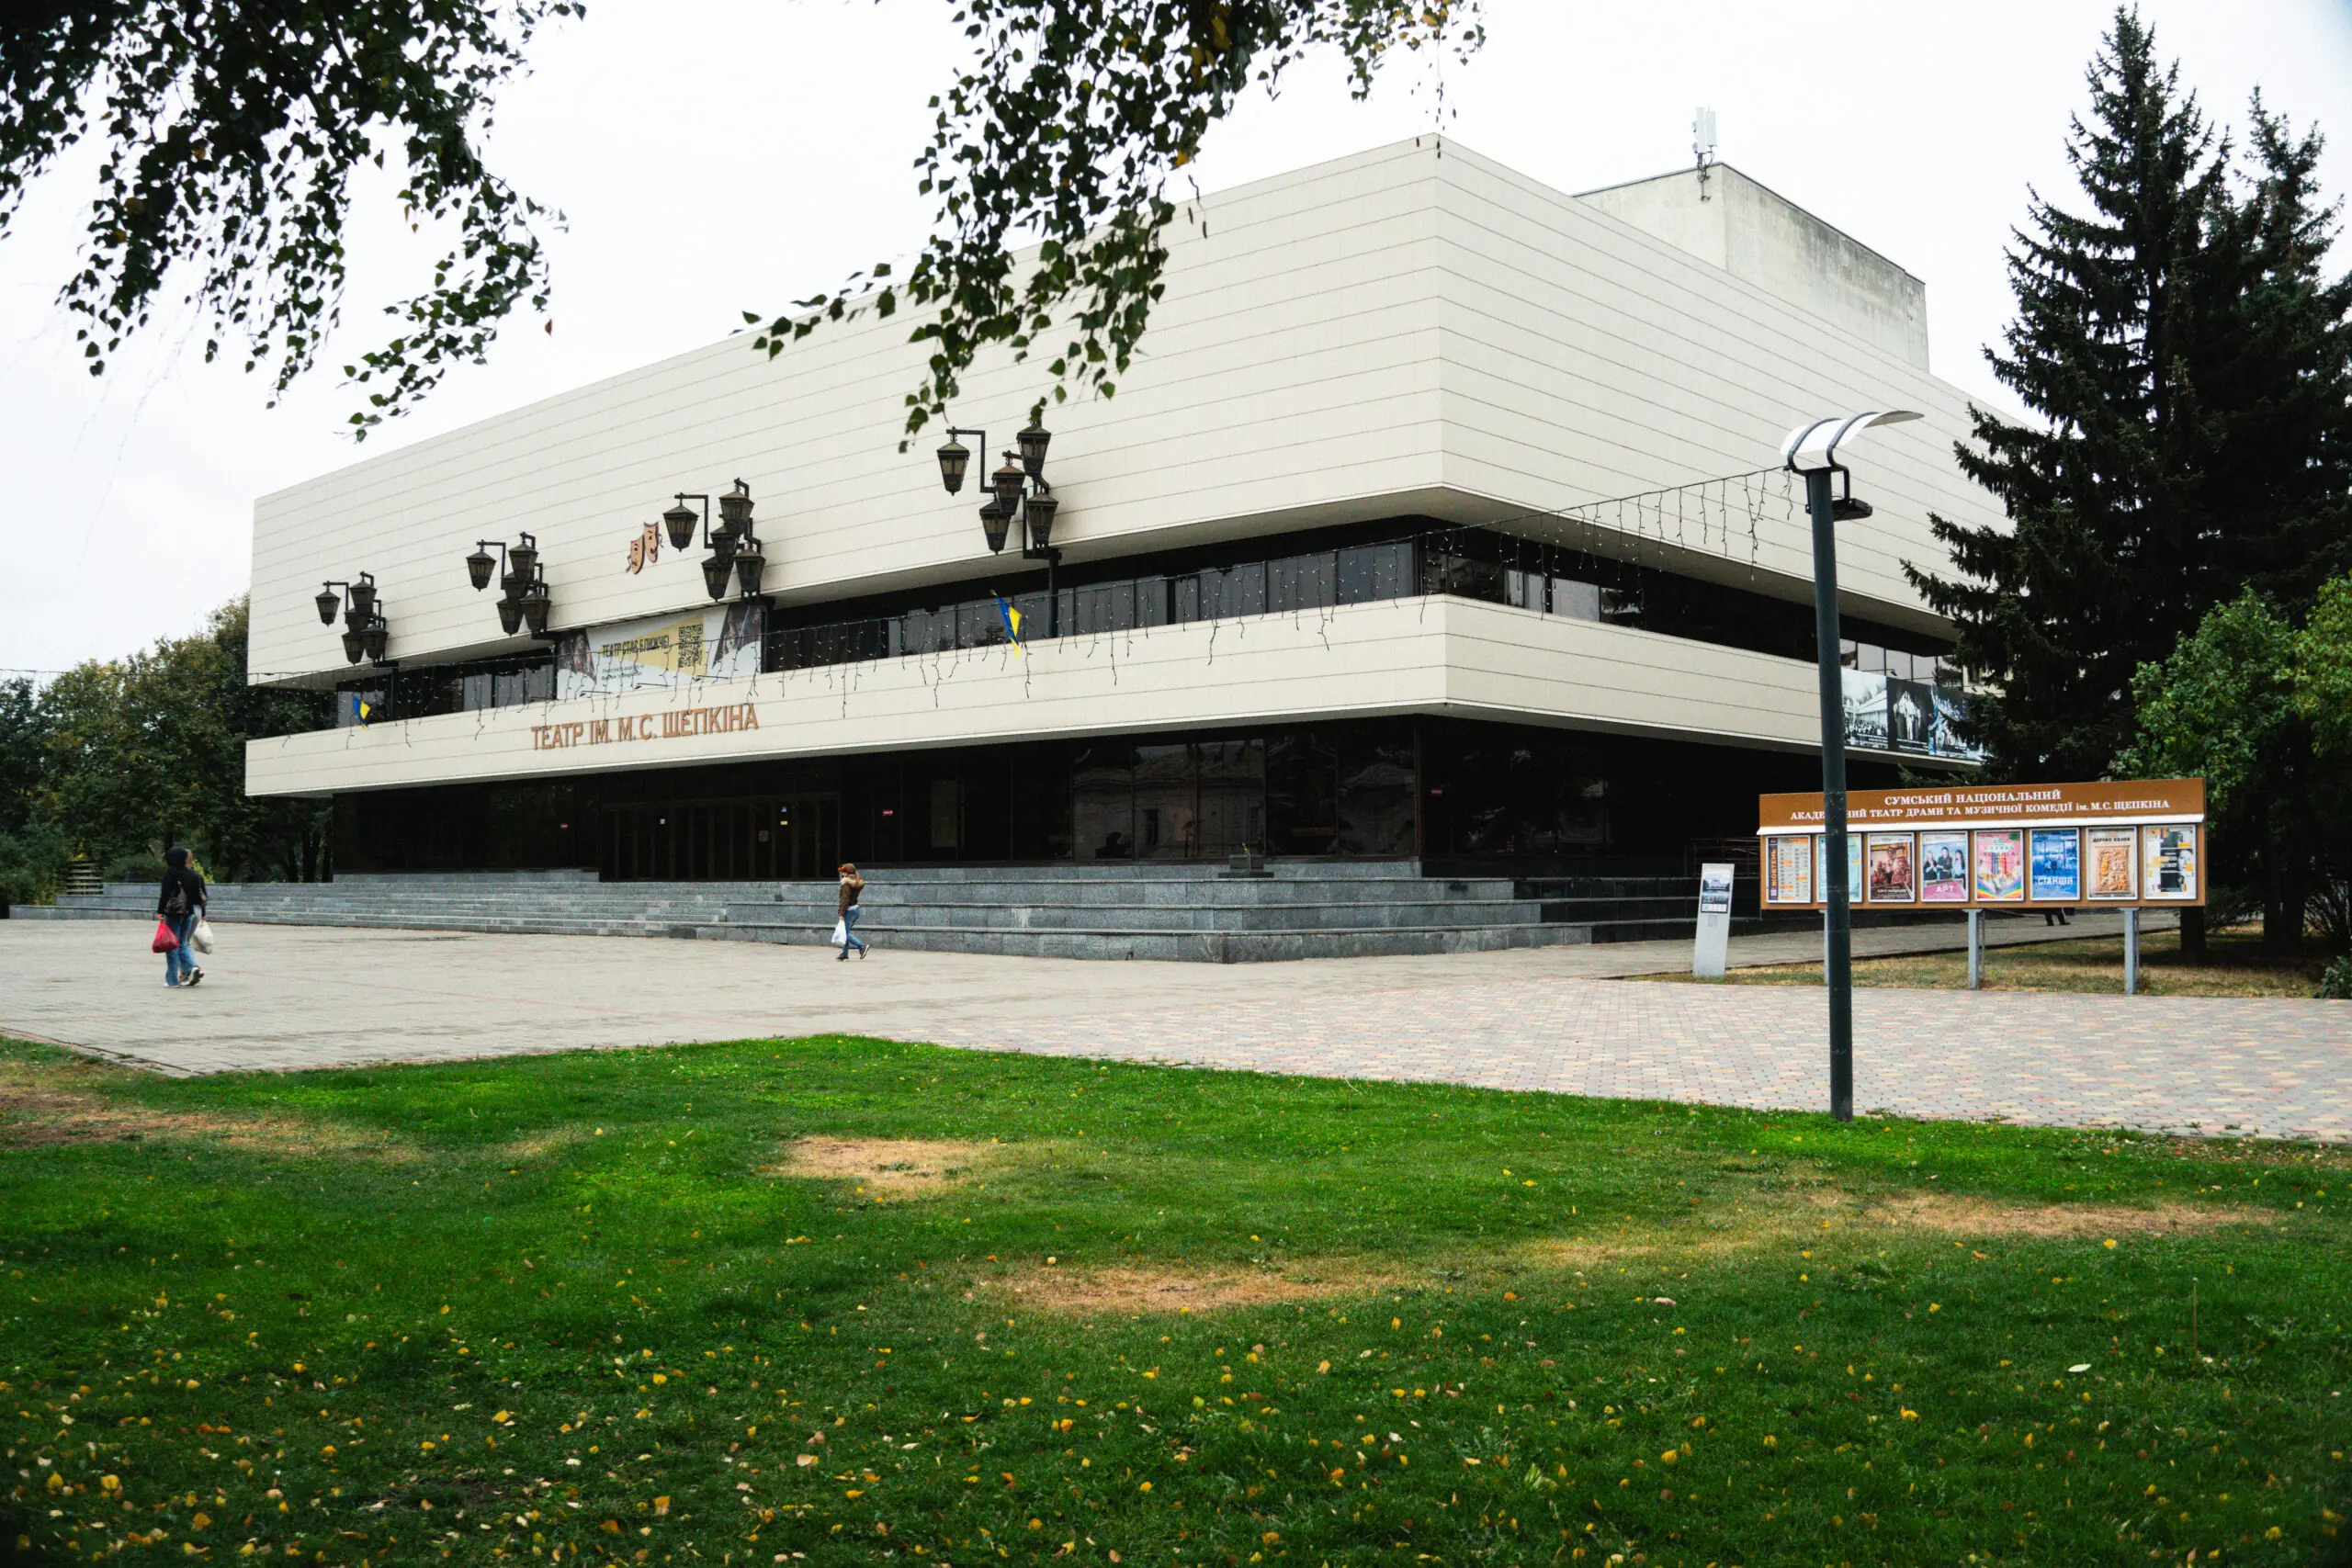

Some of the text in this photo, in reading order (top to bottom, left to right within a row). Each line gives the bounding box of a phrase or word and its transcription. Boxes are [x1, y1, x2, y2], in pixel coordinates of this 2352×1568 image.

[531, 722, 584, 750] ТЕАТР
[590, 718, 612, 745] ІМ.
[1884, 789, 2061, 806] СУМСЬКИЙ НАЦІОНАЛЬНИЙ
[1791, 808, 1866, 820] АКАДЕНИЙ
[1870, 808, 1903, 817] ТЕАТР
[1905, 807, 1944, 817] ДРАМИ
[1964, 804, 2022, 815] МУЗИЧНОЇ
[2026, 802, 2073, 813] КОМЕДІЇ
[2114, 800, 2169, 810] ЩЕПКІНА
[1936, 885, 1954, 893] АРТ
